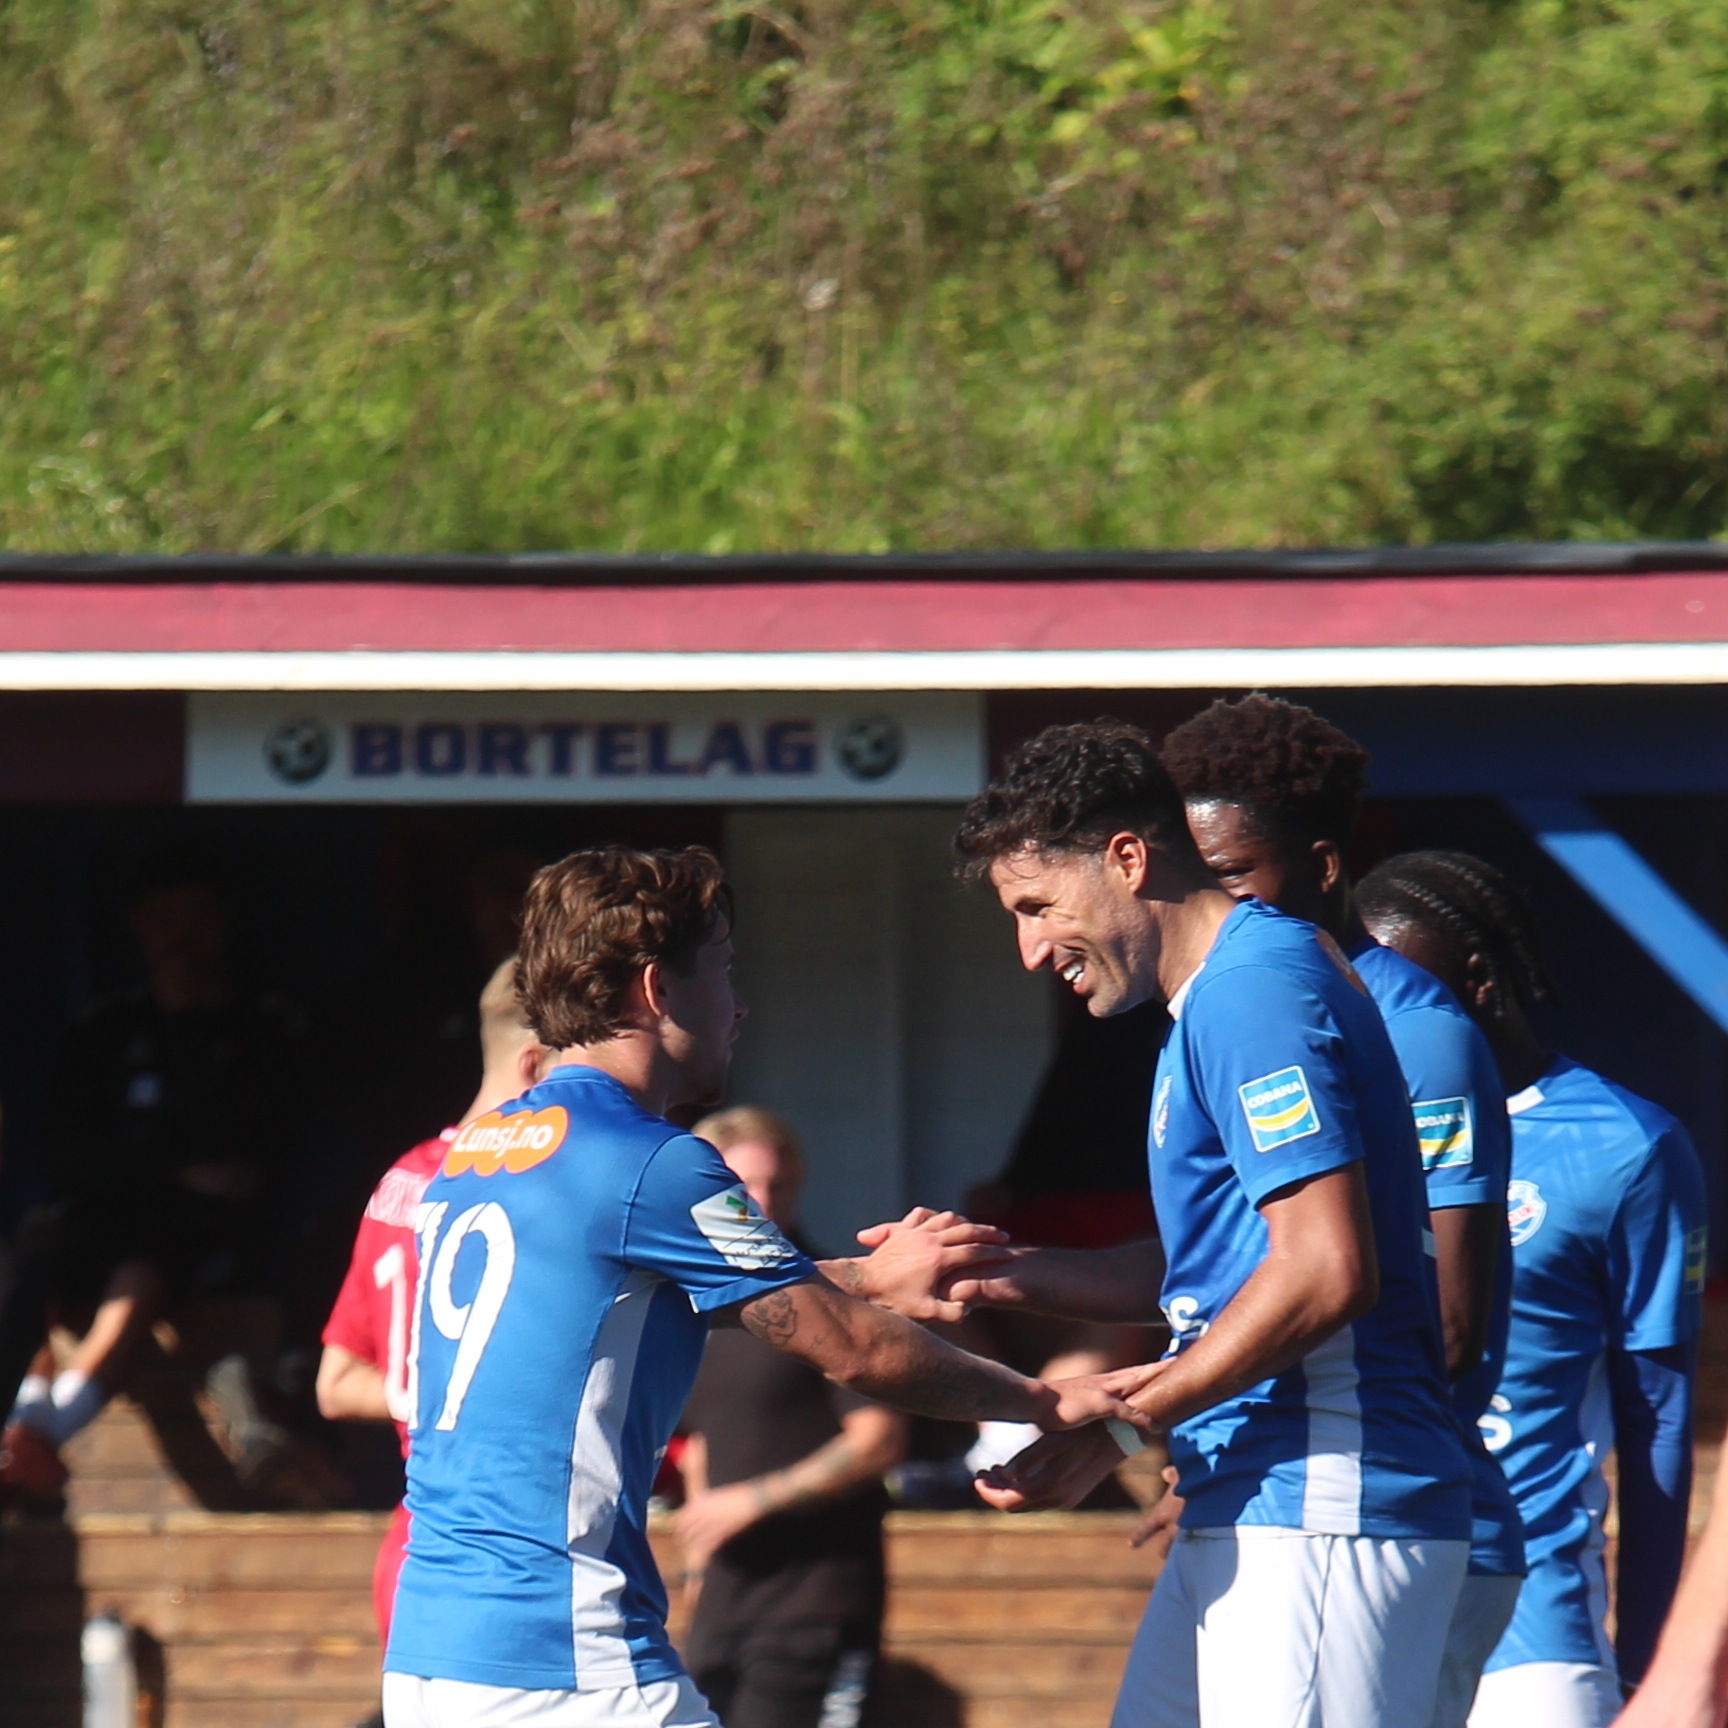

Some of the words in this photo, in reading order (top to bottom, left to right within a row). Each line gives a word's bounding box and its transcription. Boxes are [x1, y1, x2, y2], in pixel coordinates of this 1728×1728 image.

[349, 719, 818, 777] BORTELAG
[451, 1118, 554, 1160] Lunsj.no
[408, 1201, 515, 1431] 19
